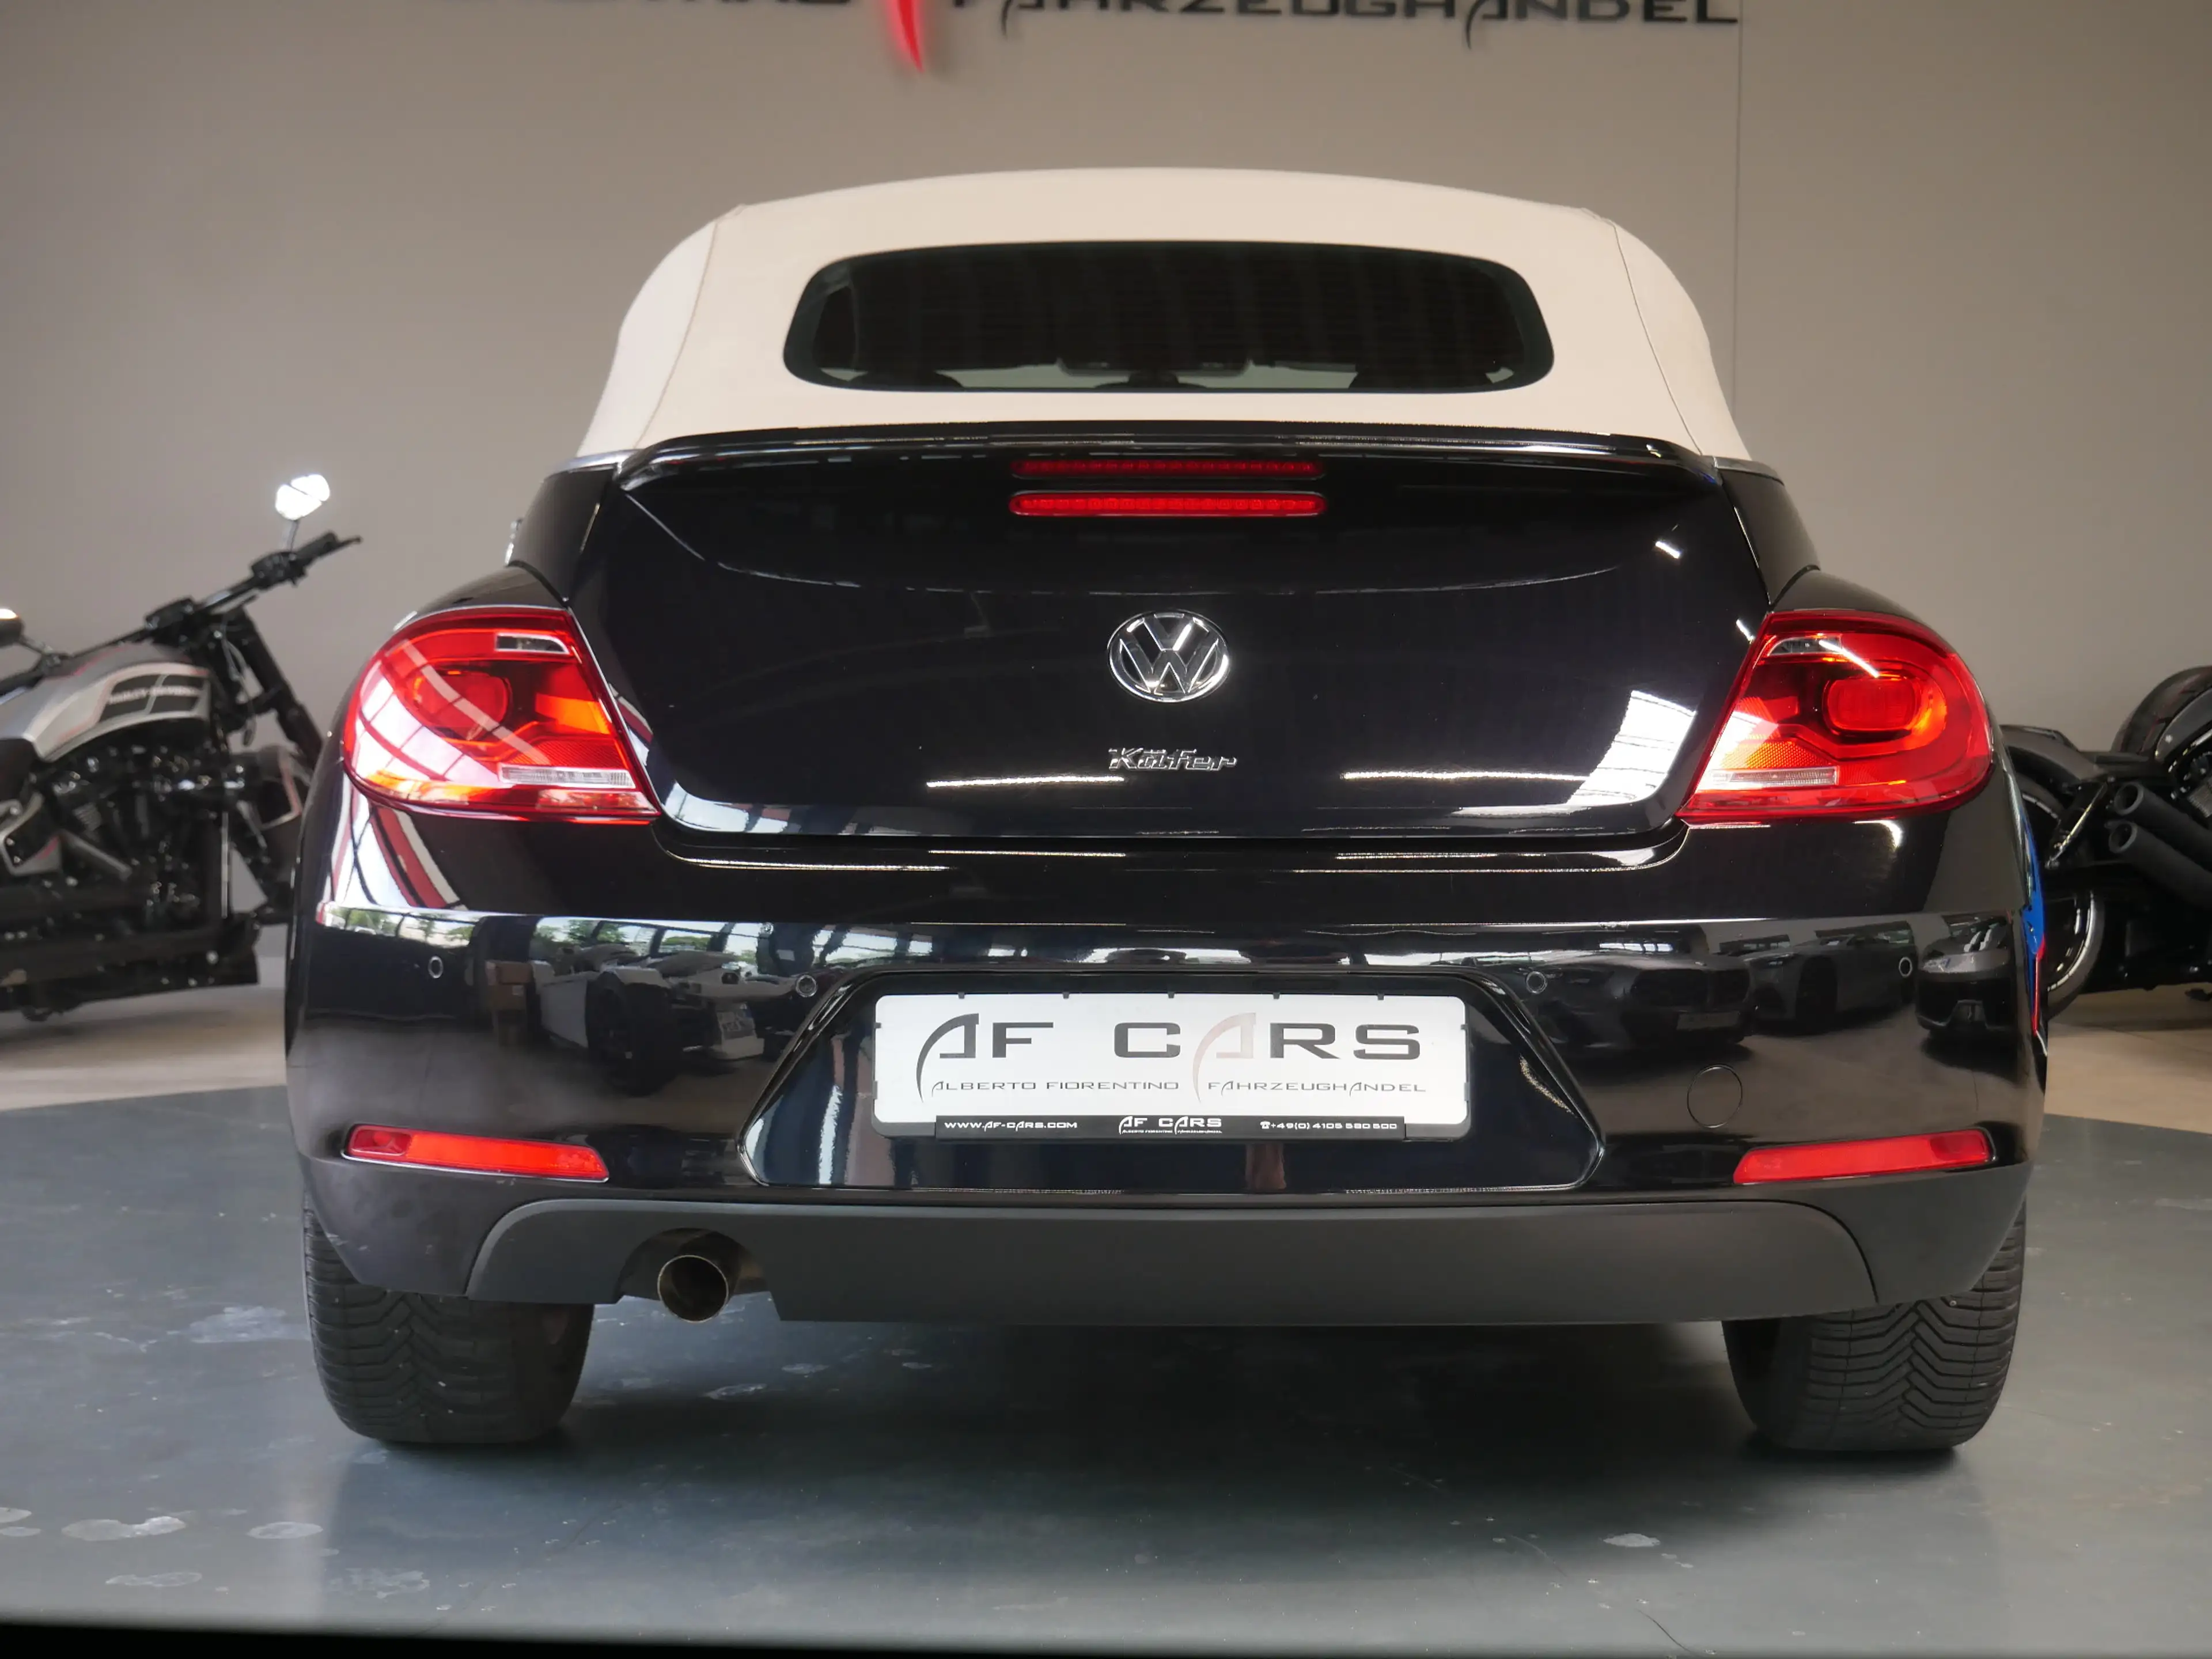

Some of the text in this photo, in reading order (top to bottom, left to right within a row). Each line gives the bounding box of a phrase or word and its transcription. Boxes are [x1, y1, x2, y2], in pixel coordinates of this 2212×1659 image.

[954, 0, 1738, 50] ZEUGHANDEL
[1115, 613, 1224, 697] VW
[1108, 747, 1237, 771] Käfer
[916, 1012, 1421, 1103] AF CARS
[931, 1080, 1426, 1097] ALBERTO FIORENTINO FAHRZEUGHANDEL
[1118, 1116, 1222, 1135] AF CARS
